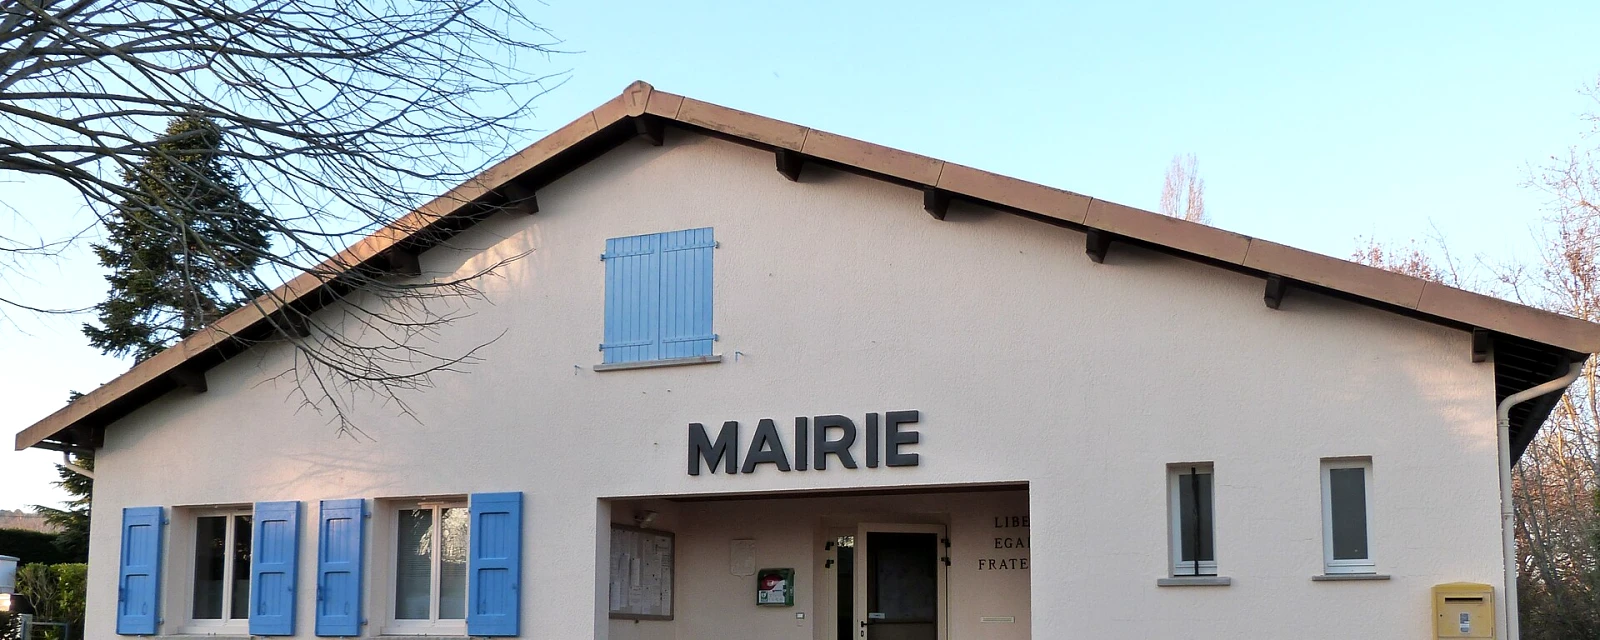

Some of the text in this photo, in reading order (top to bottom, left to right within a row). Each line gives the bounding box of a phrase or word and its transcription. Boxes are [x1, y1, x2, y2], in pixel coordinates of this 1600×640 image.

[687, 410, 919, 476] MAIRIE
[994, 516, 1030, 528] LIBE
[978, 558, 1029, 570] FRATE
